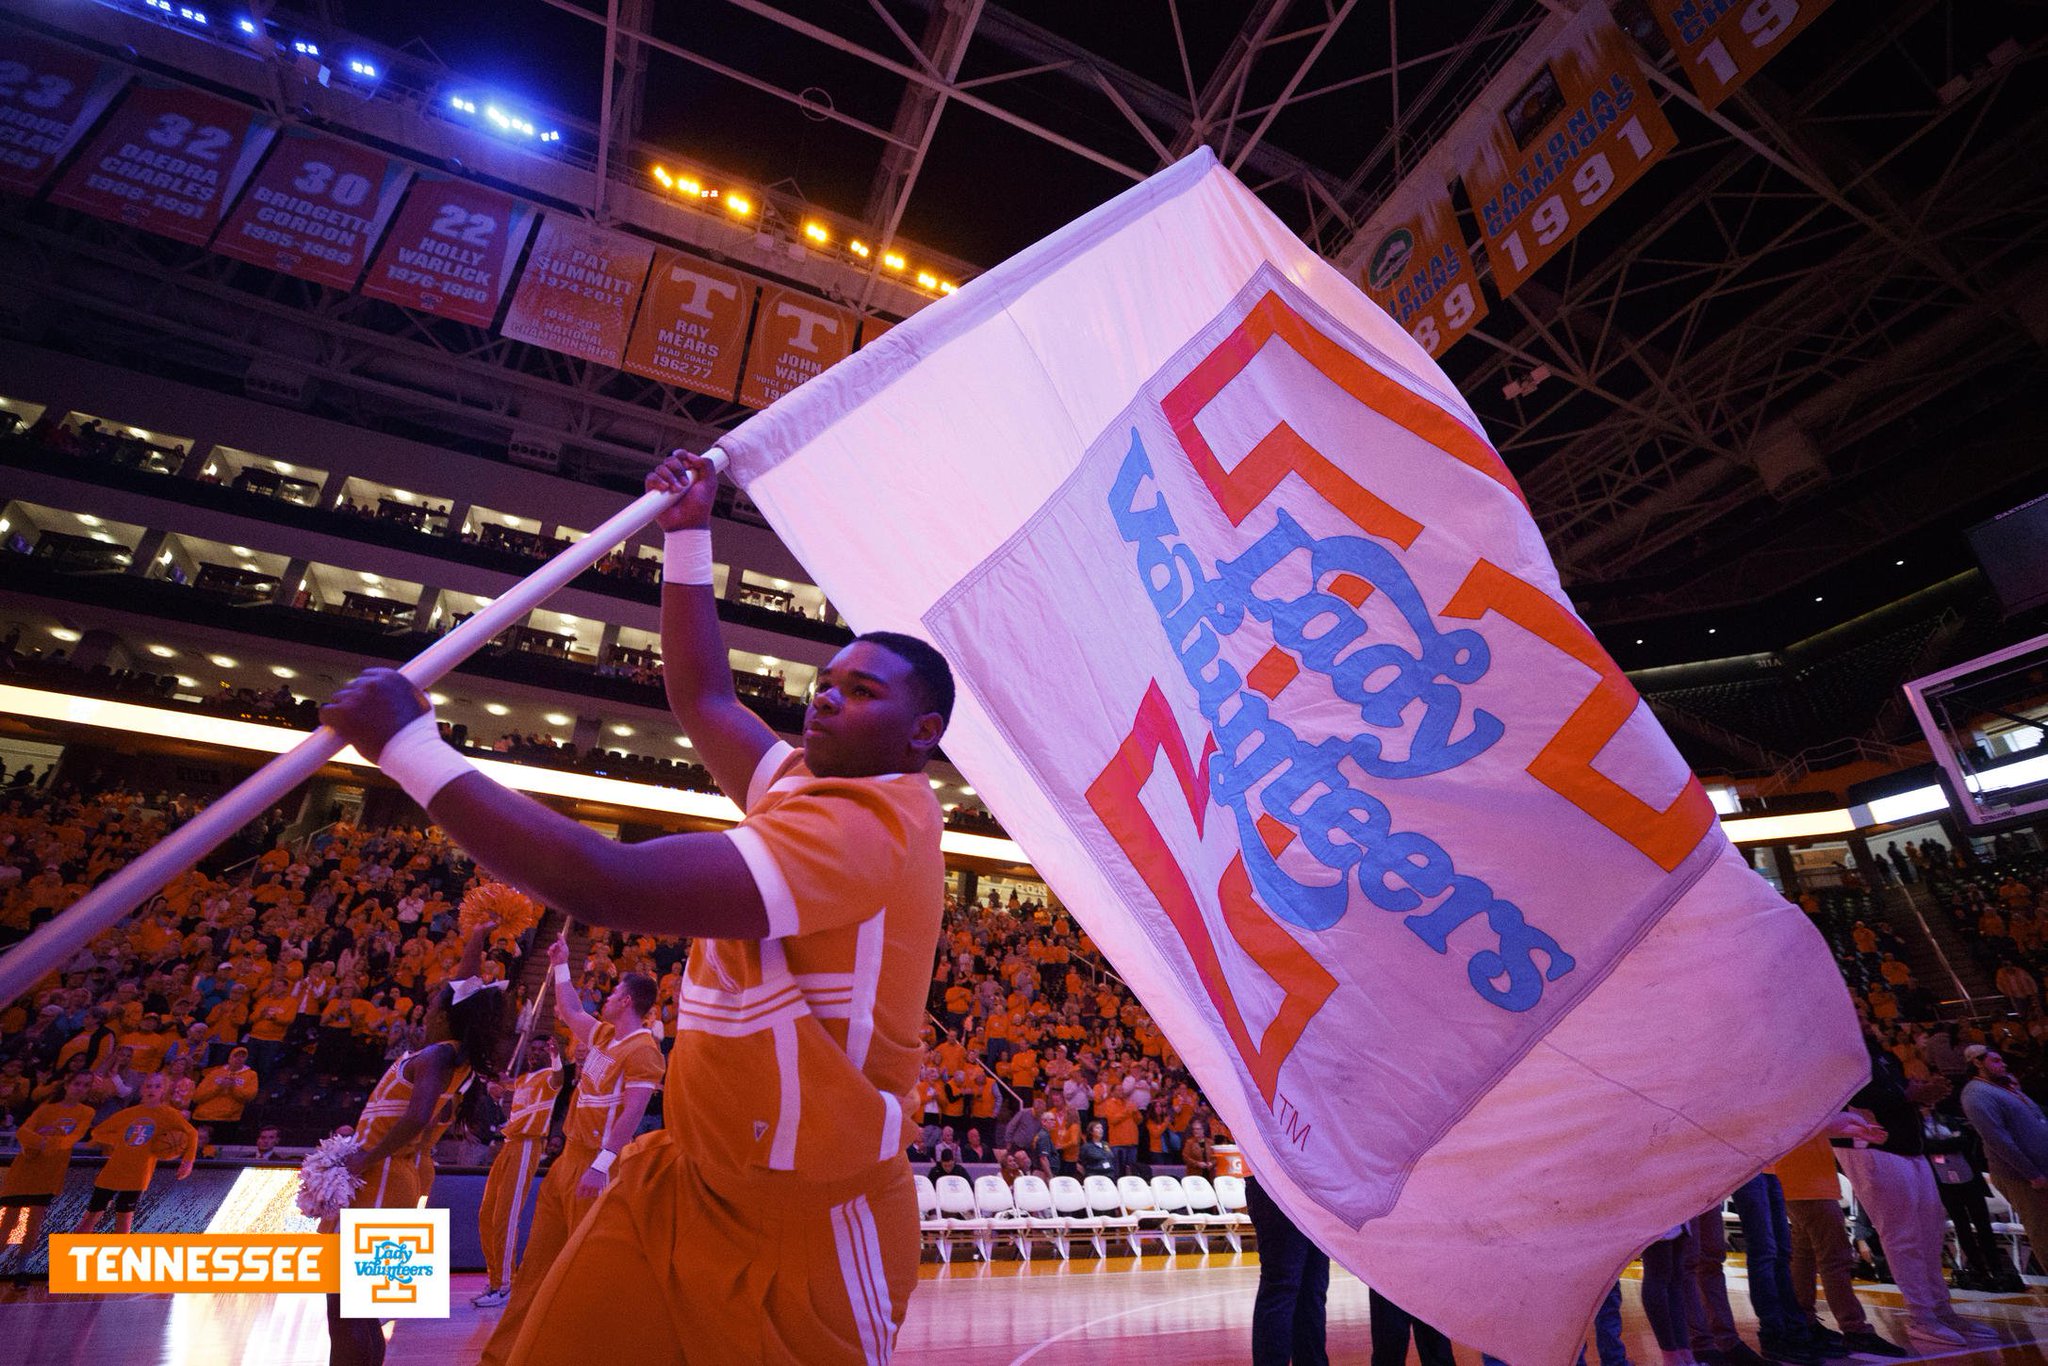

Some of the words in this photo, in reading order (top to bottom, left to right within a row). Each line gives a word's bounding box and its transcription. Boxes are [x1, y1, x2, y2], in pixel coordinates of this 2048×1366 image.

[1696, 0, 1800, 86] 19
[144, 112, 233, 162] 32
[1482, 71, 1632, 223] NATIONAL
[99, 156, 217, 202] CHARLES
[118, 143, 219, 186] DAEDRA
[292, 161, 372, 207] 30
[1486, 86, 1636, 239] CHAMPIONS
[254, 186, 378, 236] BRIDGETTE
[1500, 114, 1653, 273] 1991
[256, 207, 357, 247] GORDON
[431, 204, 497, 248] 22
[398, 247, 492, 286] WARLICK
[418, 237, 486, 266] HOLLY
[571, 250, 610, 273] PAT
[536, 255, 633, 295] SUMMITT
[670, 266, 738, 320] T
[1389, 242, 1458, 315] IONAL
[1396, 255, 1461, 323] PIONS
[511, 322, 617, 360] CHAMPIONSHIPS
[544, 322, 603, 346] NATIONAL
[675, 319, 710, 339] RAY
[777, 301, 839, 353] T
[1412, 282, 1476, 355] 89
[657, 328, 719, 358] MEARS
[657, 345, 680, 357] HEAD
[683, 353, 713, 367] COACH
[778, 353, 823, 375] JOHN
[775, 365, 813, 384] WAR
[1204, 506, 1506, 780] Lady
[1107, 426, 1576, 1013] Volunteers
[1277, 1092, 1312, 1153] TM
